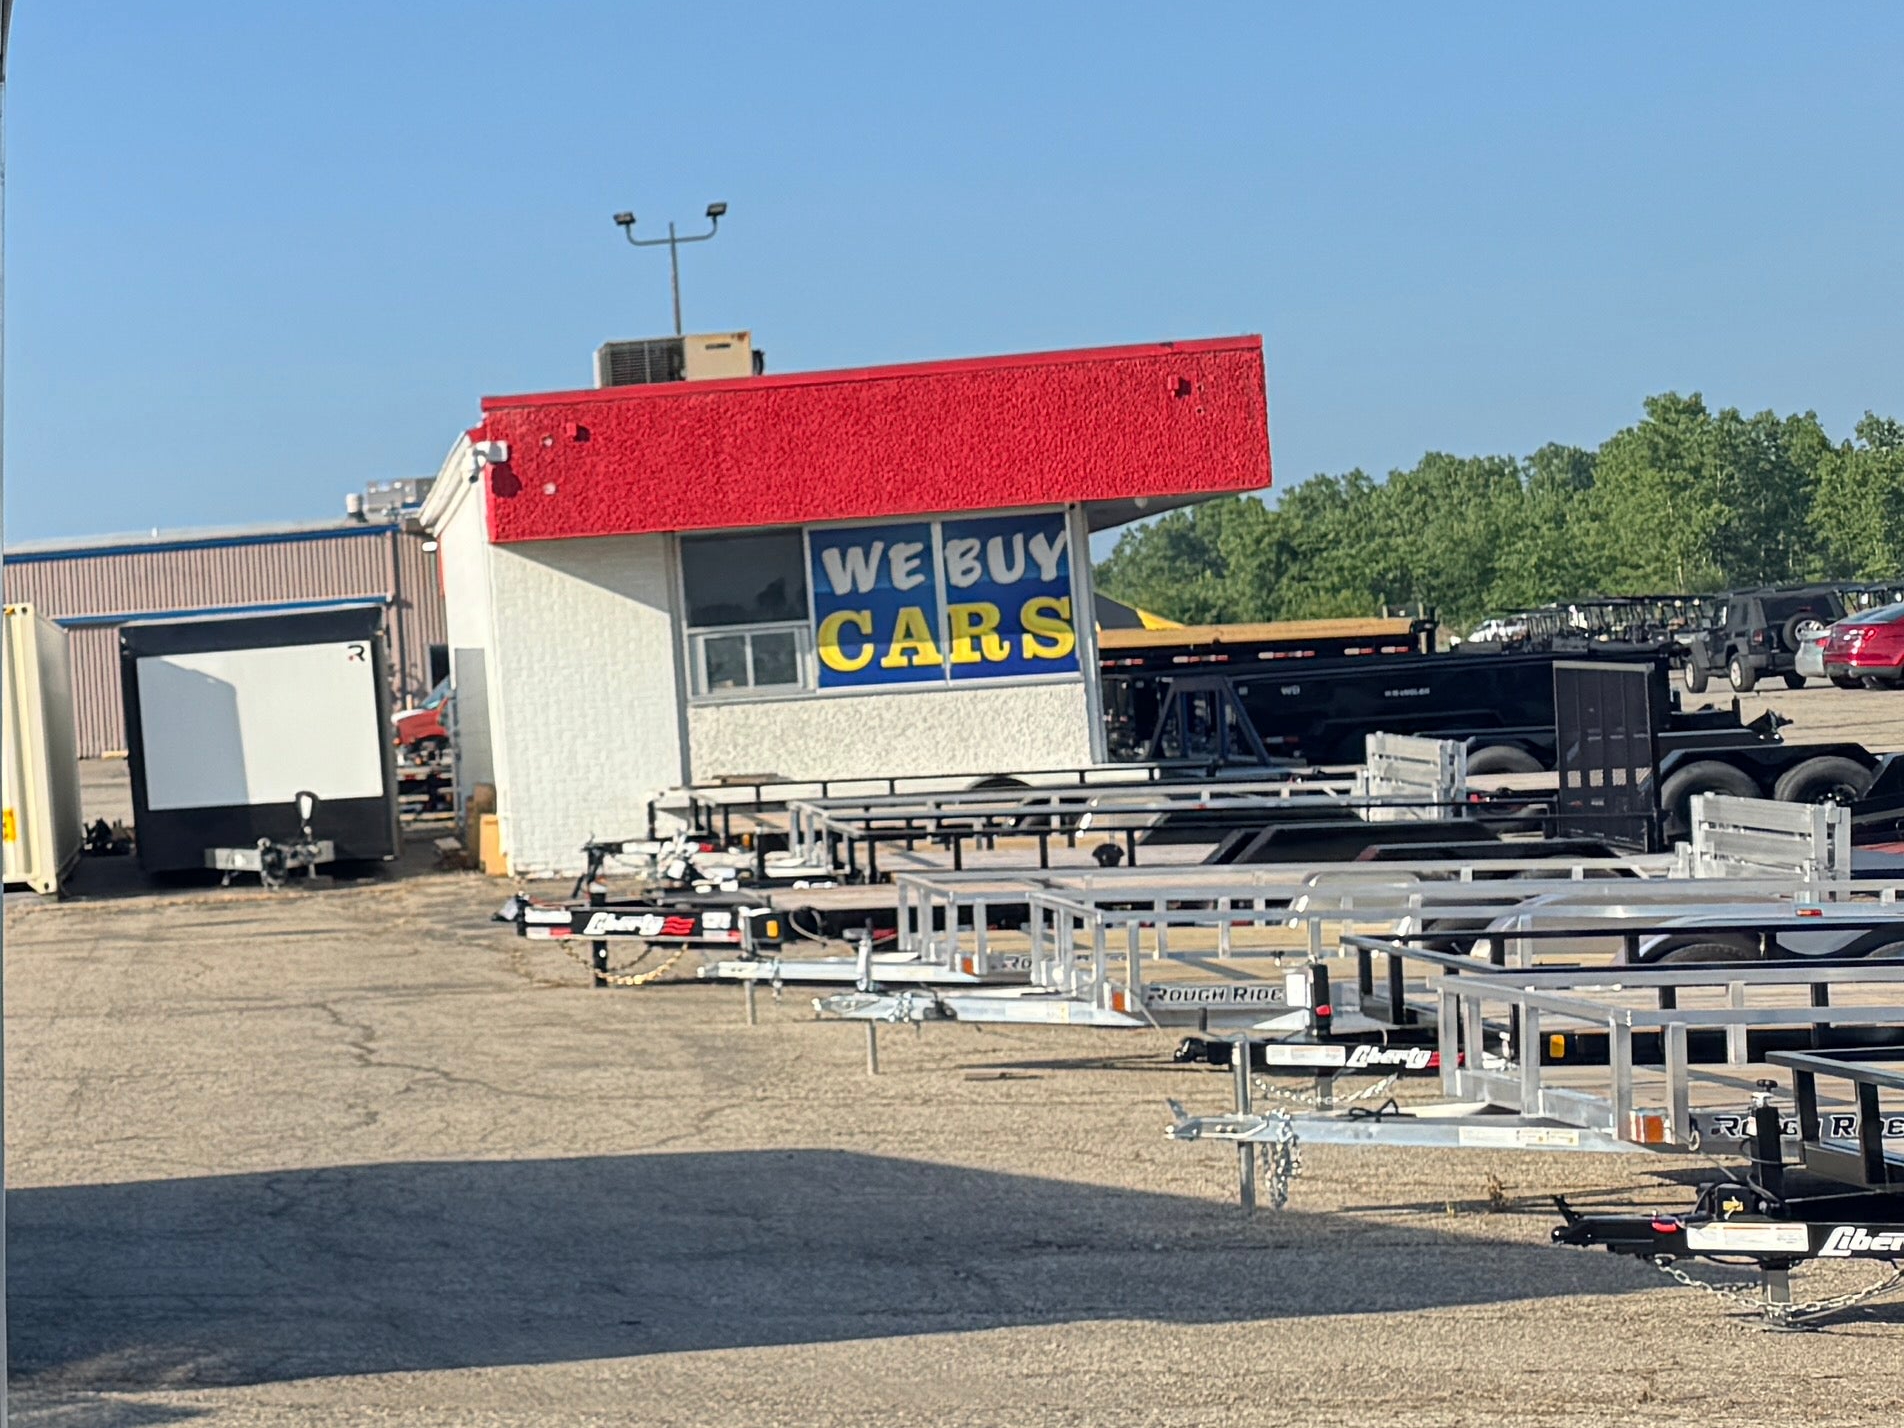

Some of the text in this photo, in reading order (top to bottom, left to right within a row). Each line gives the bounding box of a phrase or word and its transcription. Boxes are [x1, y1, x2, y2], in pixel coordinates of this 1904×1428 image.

[821, 529, 1067, 596] WE BUY
[817, 595, 1076, 672] CARS
[1230, 986, 1285, 1003] RIDE
[1345, 1044, 1432, 1069] Liberty
